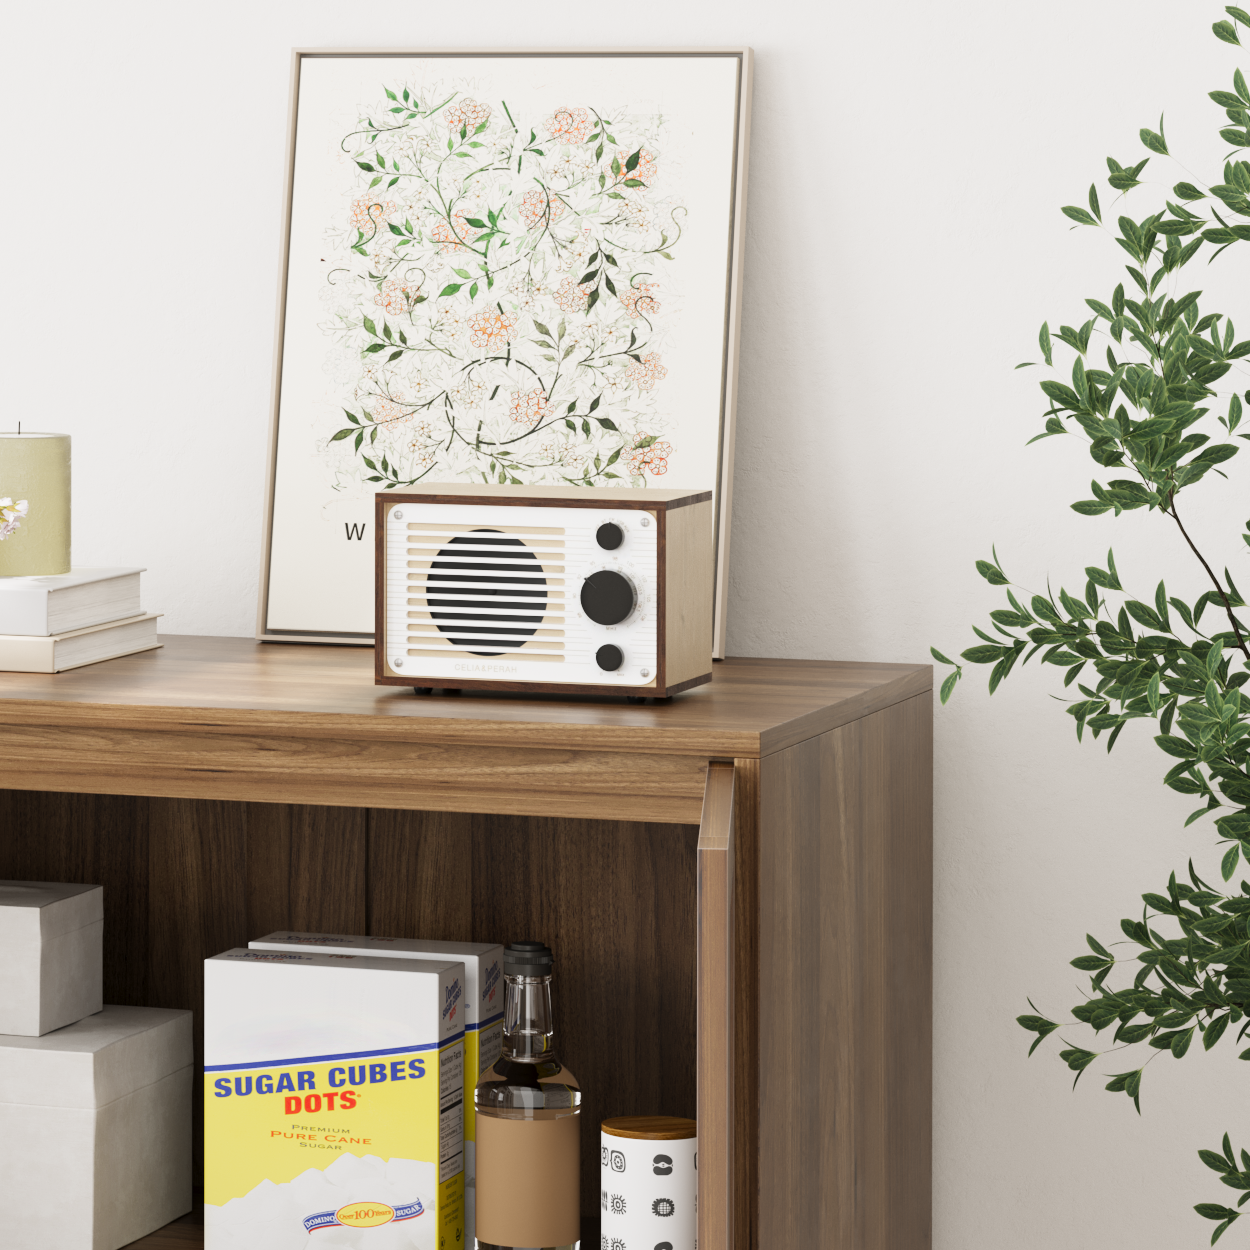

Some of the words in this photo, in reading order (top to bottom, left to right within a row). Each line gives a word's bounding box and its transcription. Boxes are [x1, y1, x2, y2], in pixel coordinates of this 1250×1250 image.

[454, 663, 518, 674] CELIA&PERAH
[214, 1070, 316, 1098] SUGAR
[328, 1058, 426, 1088] CUBES
[284, 1090, 357, 1115] DOTS
[291, 1124, 350, 1134] PREMIUM
[270, 1130, 317, 1141] PURE
[324, 1135, 372, 1145] CANE
[299, 1141, 342, 1150] SUGAR
[304, 1214, 335, 1229] DOMINO
[396, 1203, 421, 1217] SUGAR
